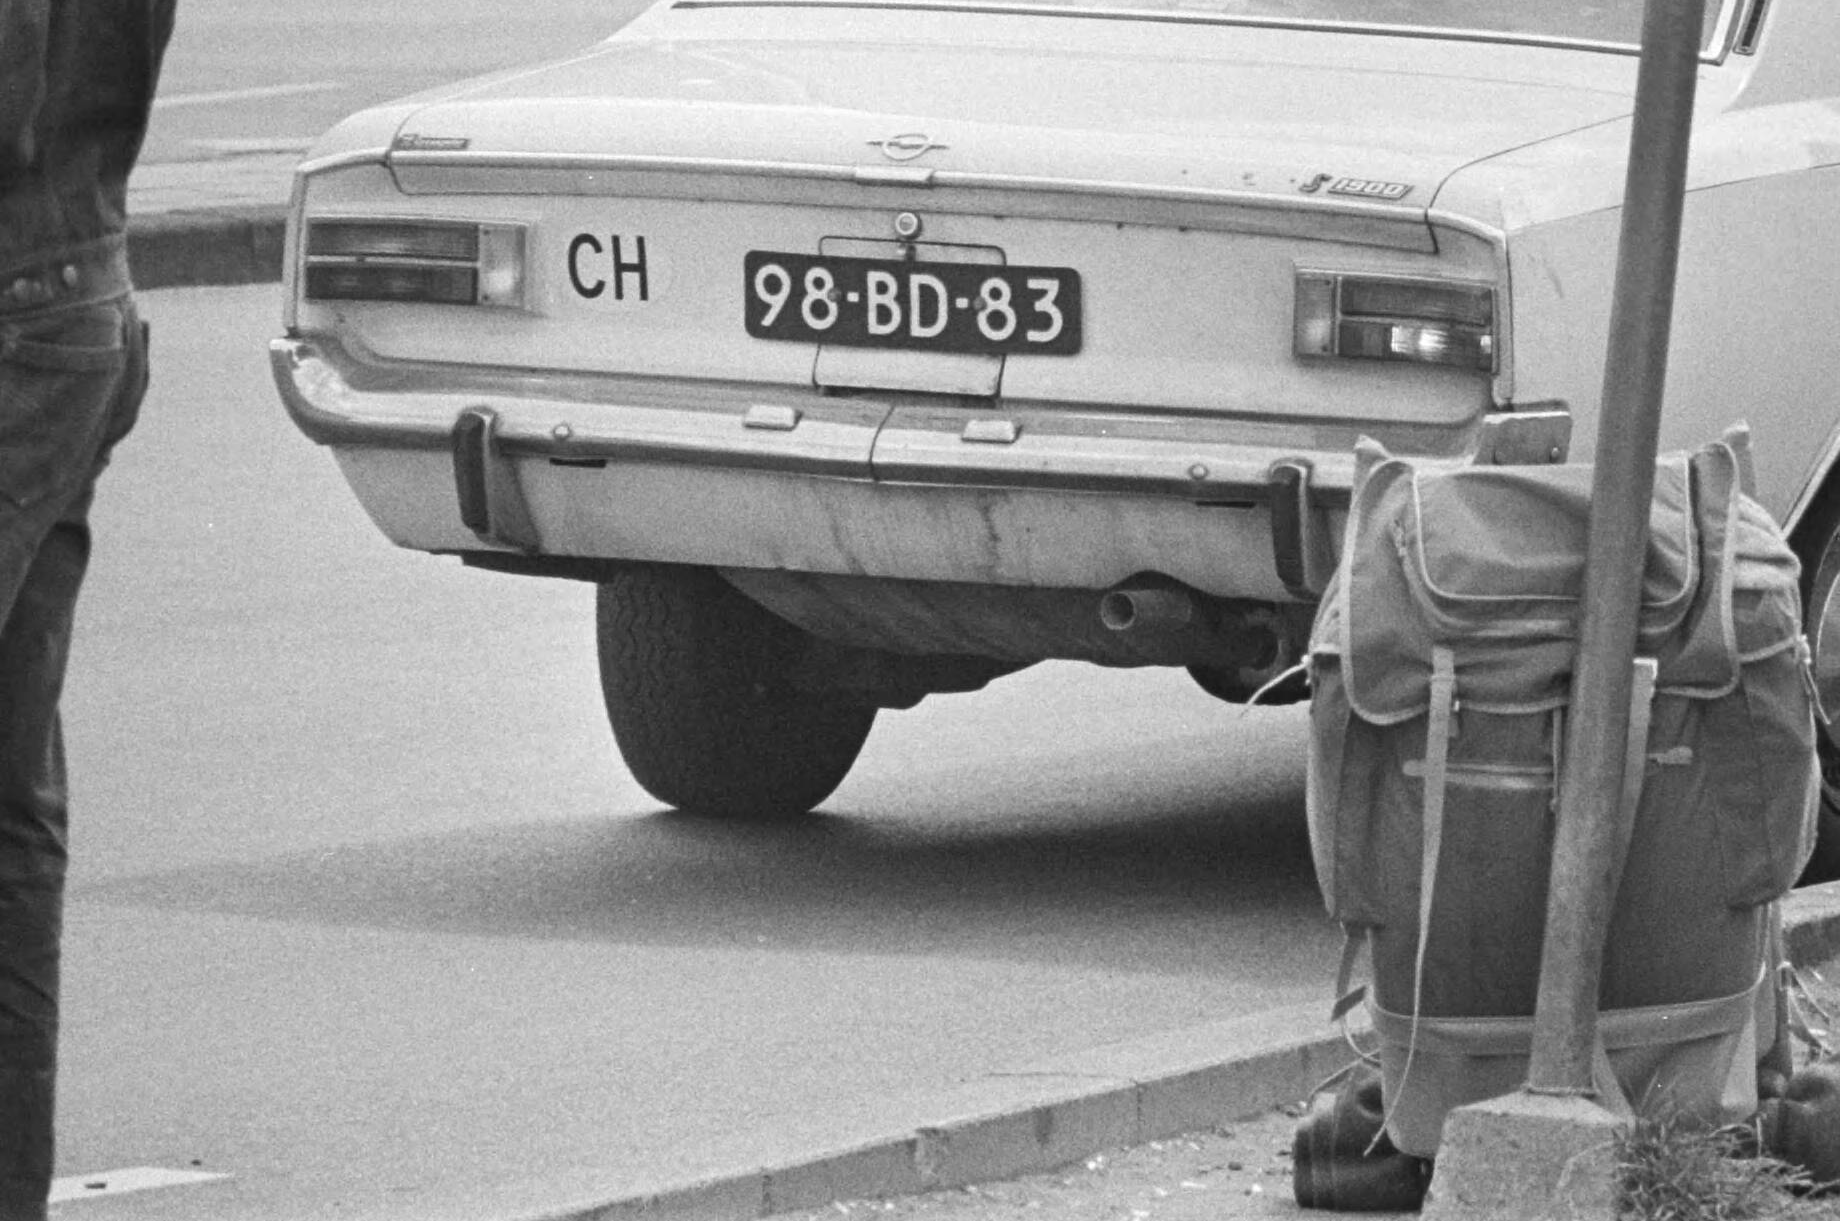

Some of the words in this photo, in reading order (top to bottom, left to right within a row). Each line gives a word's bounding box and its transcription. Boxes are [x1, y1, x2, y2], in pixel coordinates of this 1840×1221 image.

[1330, 178, 1406, 198] 1900
[567, 233, 649, 301] CH
[755, 264, 1063, 343] 98-BD-83
